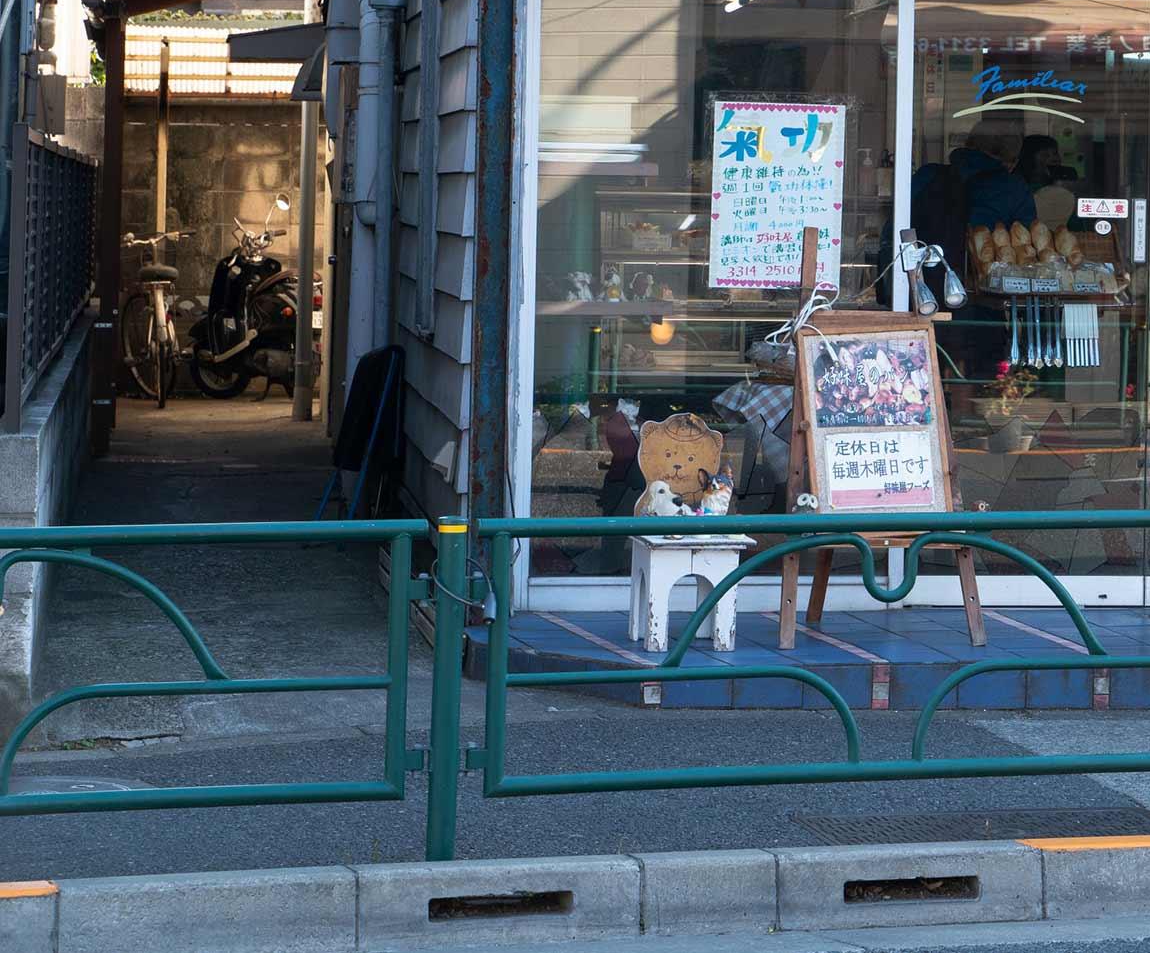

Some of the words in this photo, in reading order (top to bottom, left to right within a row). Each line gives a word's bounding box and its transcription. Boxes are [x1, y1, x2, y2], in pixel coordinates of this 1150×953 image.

[970, 65, 1088, 104] Familiar
[834, 440, 899, 457] 定休日は
[832, 455, 929, 480] 毎週木曜日です
